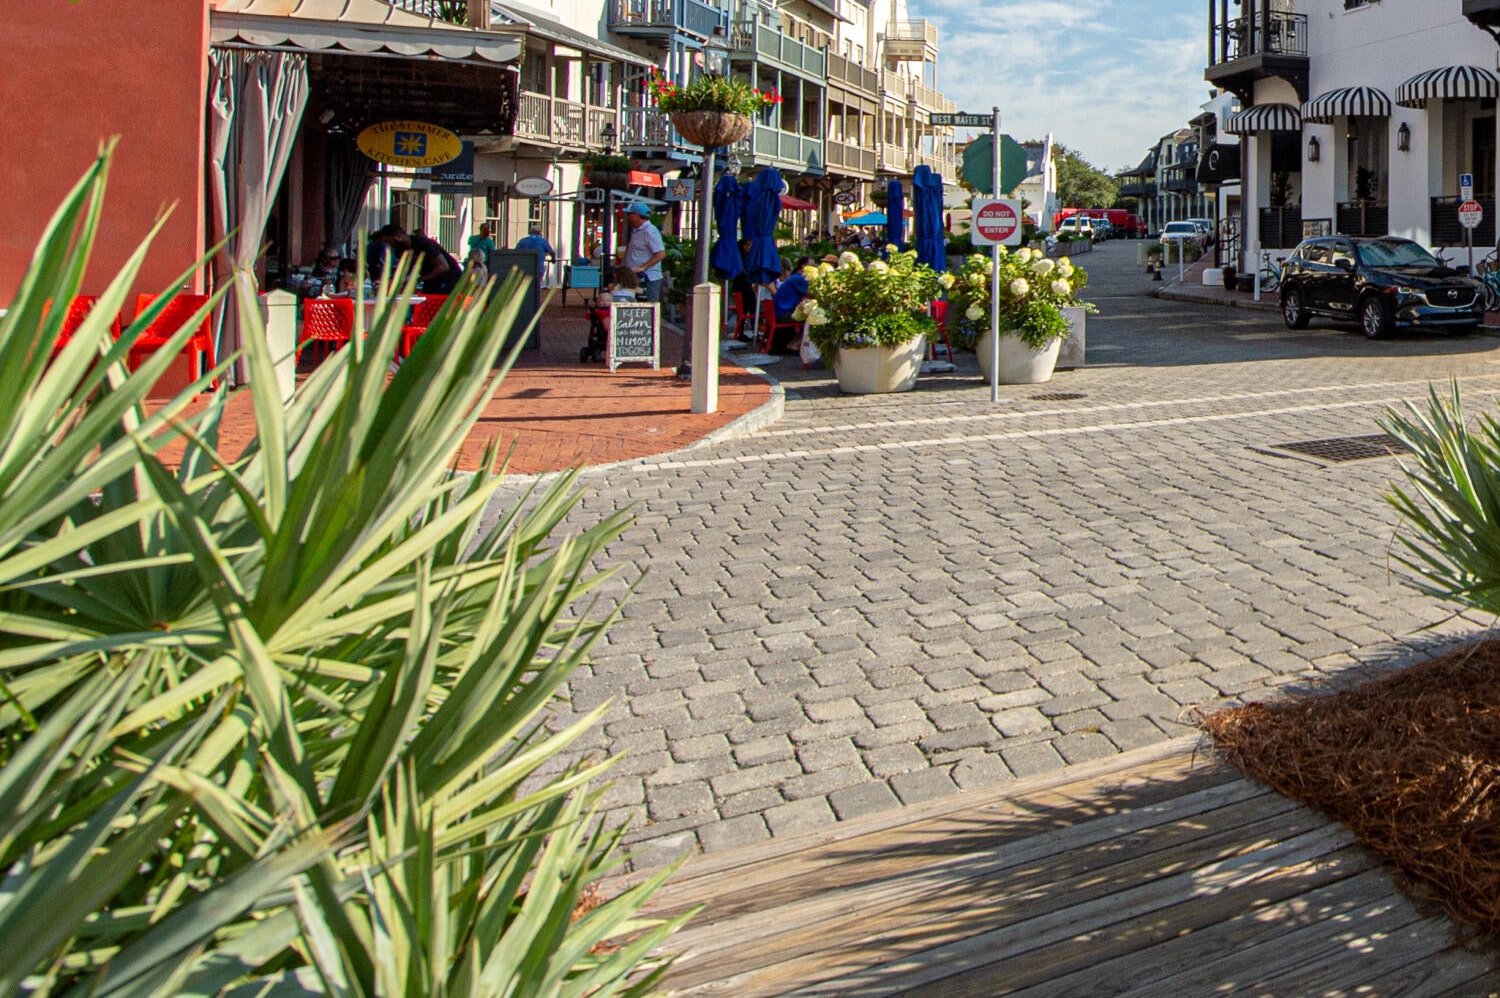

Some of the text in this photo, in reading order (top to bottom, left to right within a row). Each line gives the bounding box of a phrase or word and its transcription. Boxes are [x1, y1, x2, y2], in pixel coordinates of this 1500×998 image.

[931, 114, 952, 125] WEST
[954, 115, 979, 125] WATER
[399, 121, 450, 139] SUMMER
[367, 147, 420, 165] KITCHEN
[622, 308, 648, 318] KEEP
[616, 318, 652, 330] calm
